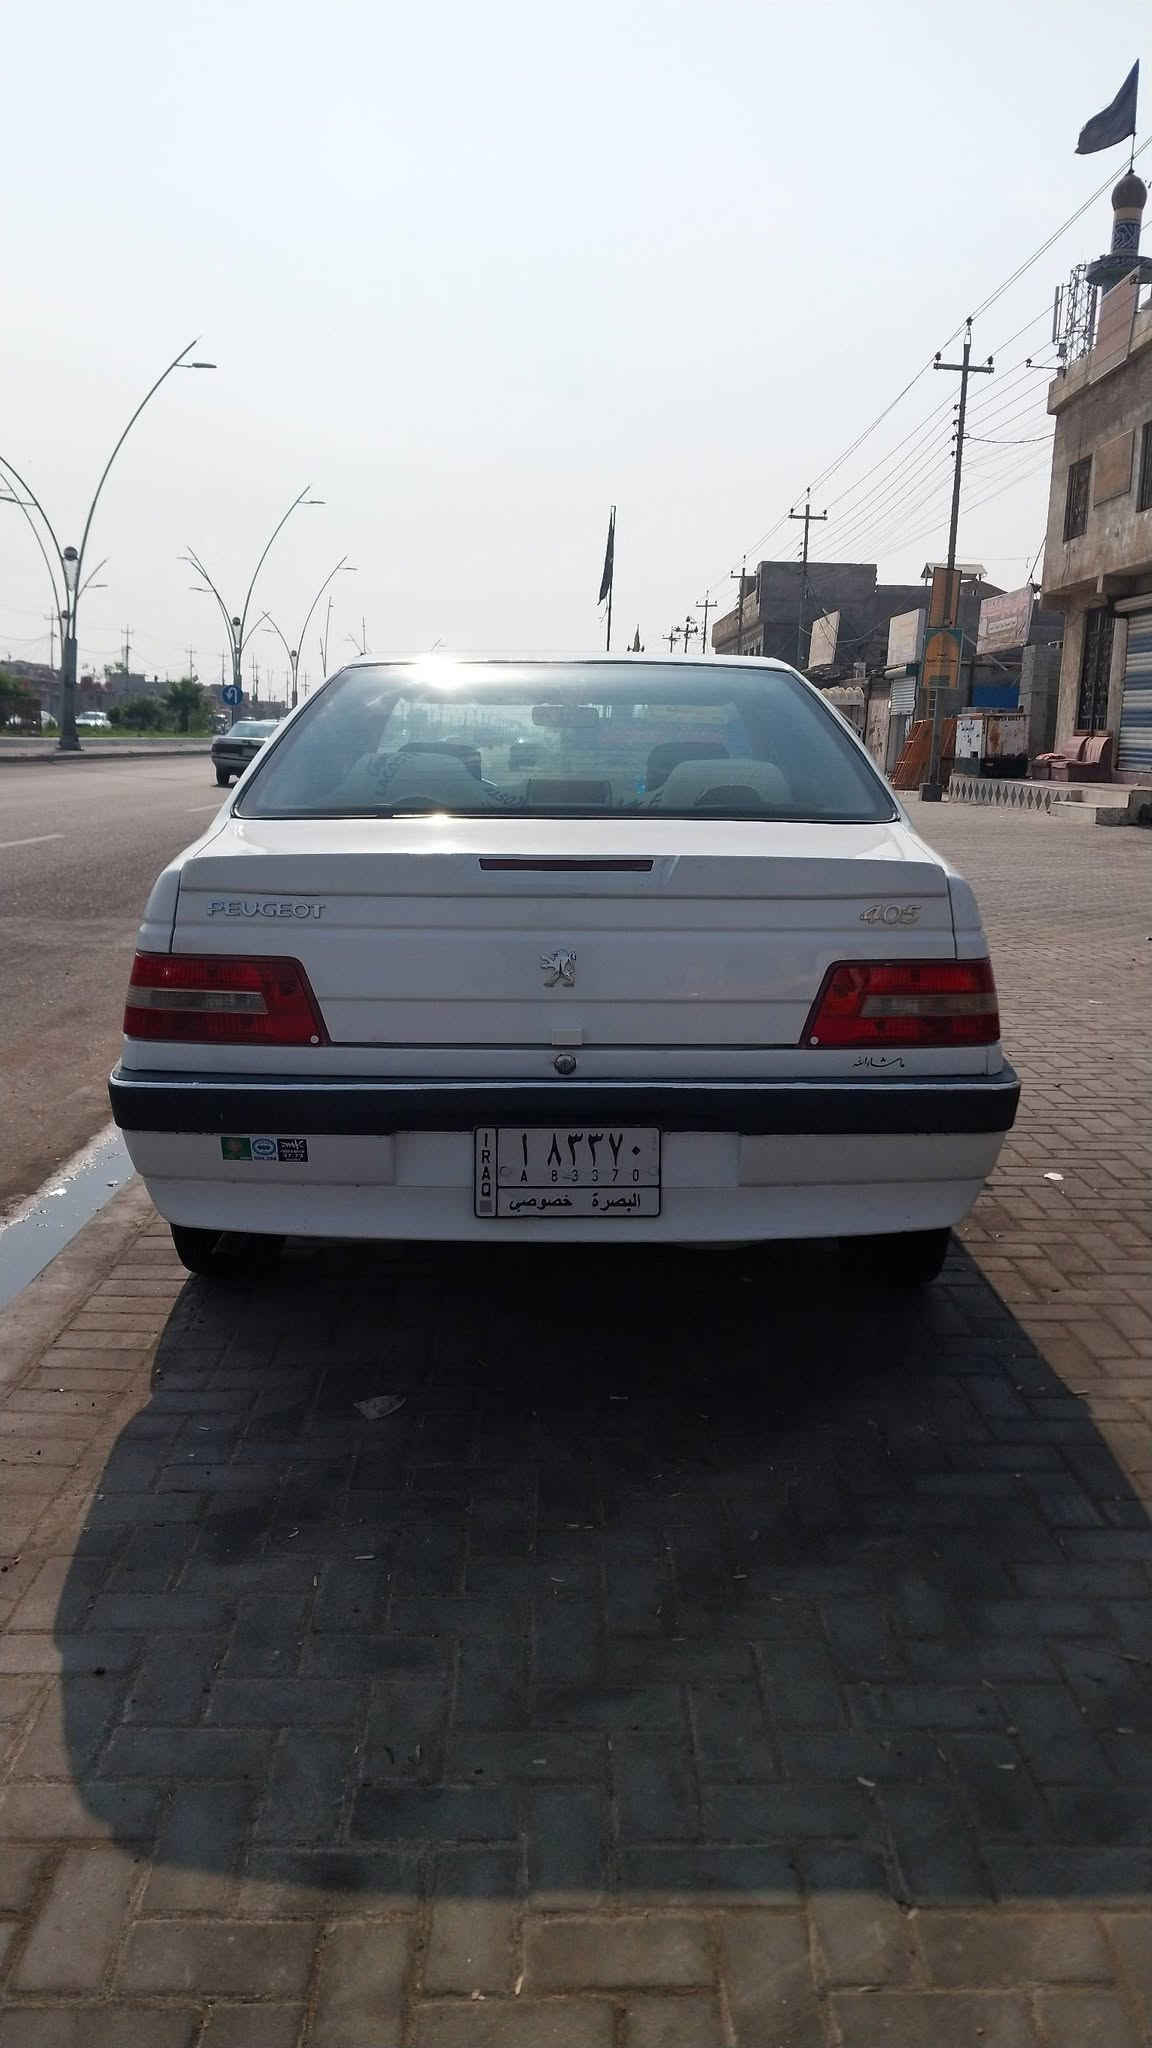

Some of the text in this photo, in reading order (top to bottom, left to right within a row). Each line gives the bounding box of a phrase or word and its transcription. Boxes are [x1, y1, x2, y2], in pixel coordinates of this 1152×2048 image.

[207, 900, 325, 919] PEUGEOT
[860, 904, 921, 926] 405
[481, 1133, 491, 1197] IRAQ
[508, 1192, 641, 1212] البصرة خصوصي
